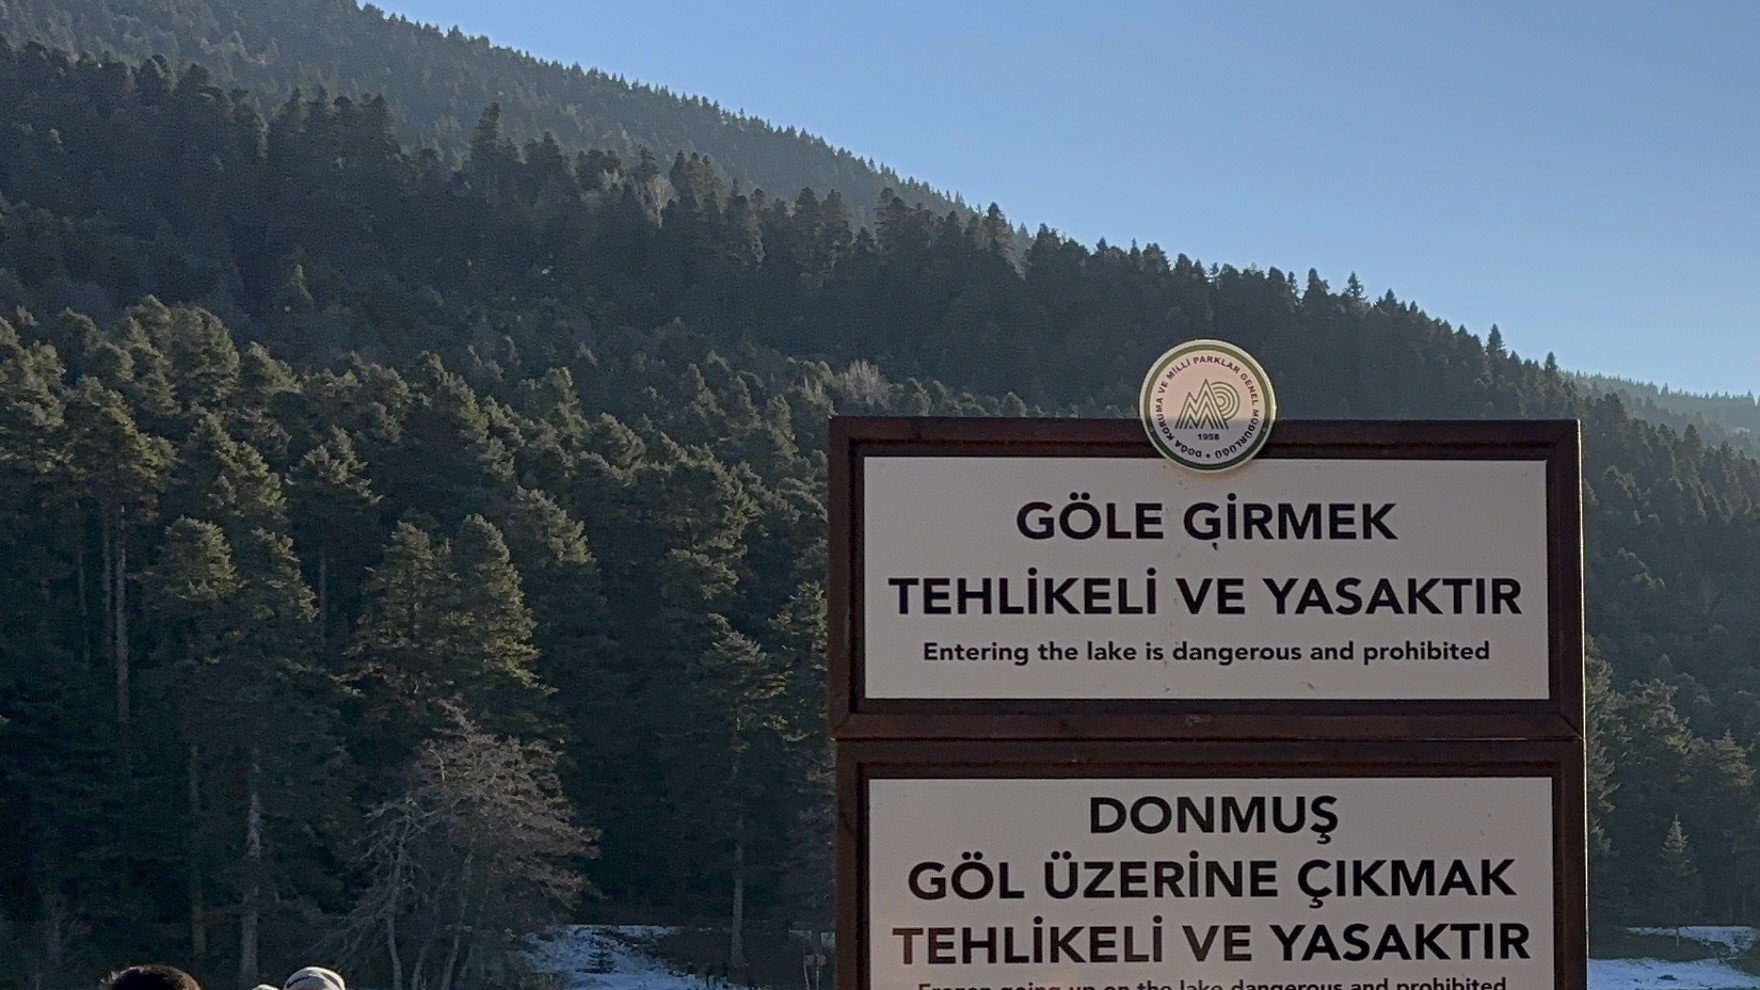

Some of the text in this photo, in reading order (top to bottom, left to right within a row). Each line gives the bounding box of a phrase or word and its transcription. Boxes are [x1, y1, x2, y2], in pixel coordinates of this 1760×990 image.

[1158, 380, 1169, 393] VE
[1193, 356, 1240, 374] PARKLAR
[1240, 373, 1260, 406] GENEL
[1155, 397, 1175, 441] KORUMA
[1017, 492, 1398, 540] GÖLE GİRMEK
[888, 567, 1523, 615] TEHLİKELİ VE YASAKTIR
[923, 640, 1490, 666] Entering the lake is dangerous and prohibited
[1091, 795, 1339, 845] DONMUŞ
[908, 850, 1518, 910] GÖL ÜZERİNE ÇIKMAK
[892, 915, 1531, 965] TEHLİKELİ VE YASAKTIR
